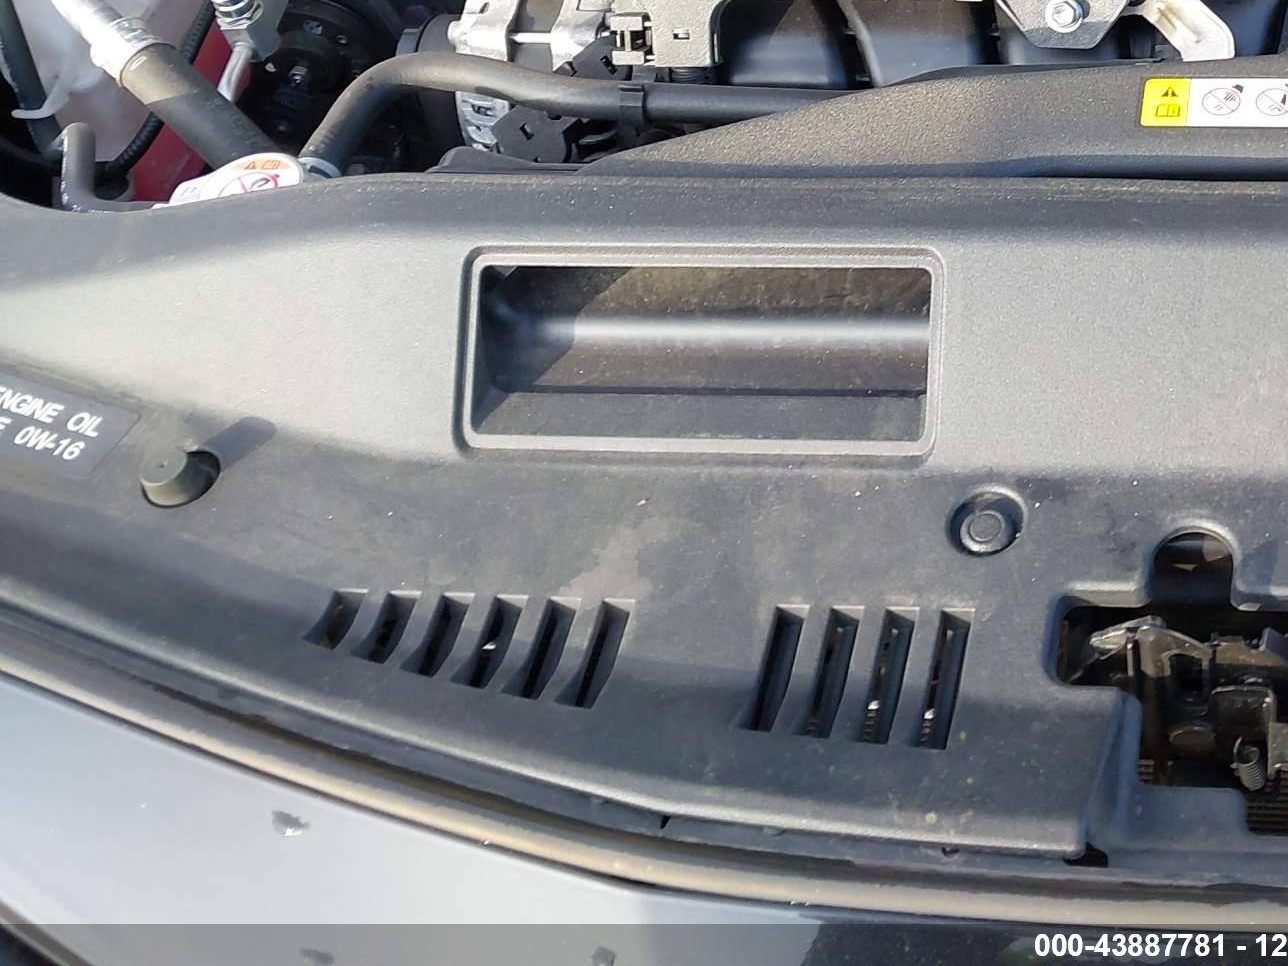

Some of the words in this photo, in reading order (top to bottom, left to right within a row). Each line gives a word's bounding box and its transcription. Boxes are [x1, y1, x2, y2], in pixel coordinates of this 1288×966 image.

[0, 385, 65, 424] NGINE
[66, 412, 104, 438] OIL
[13, 425, 86, 461] 0W-16
